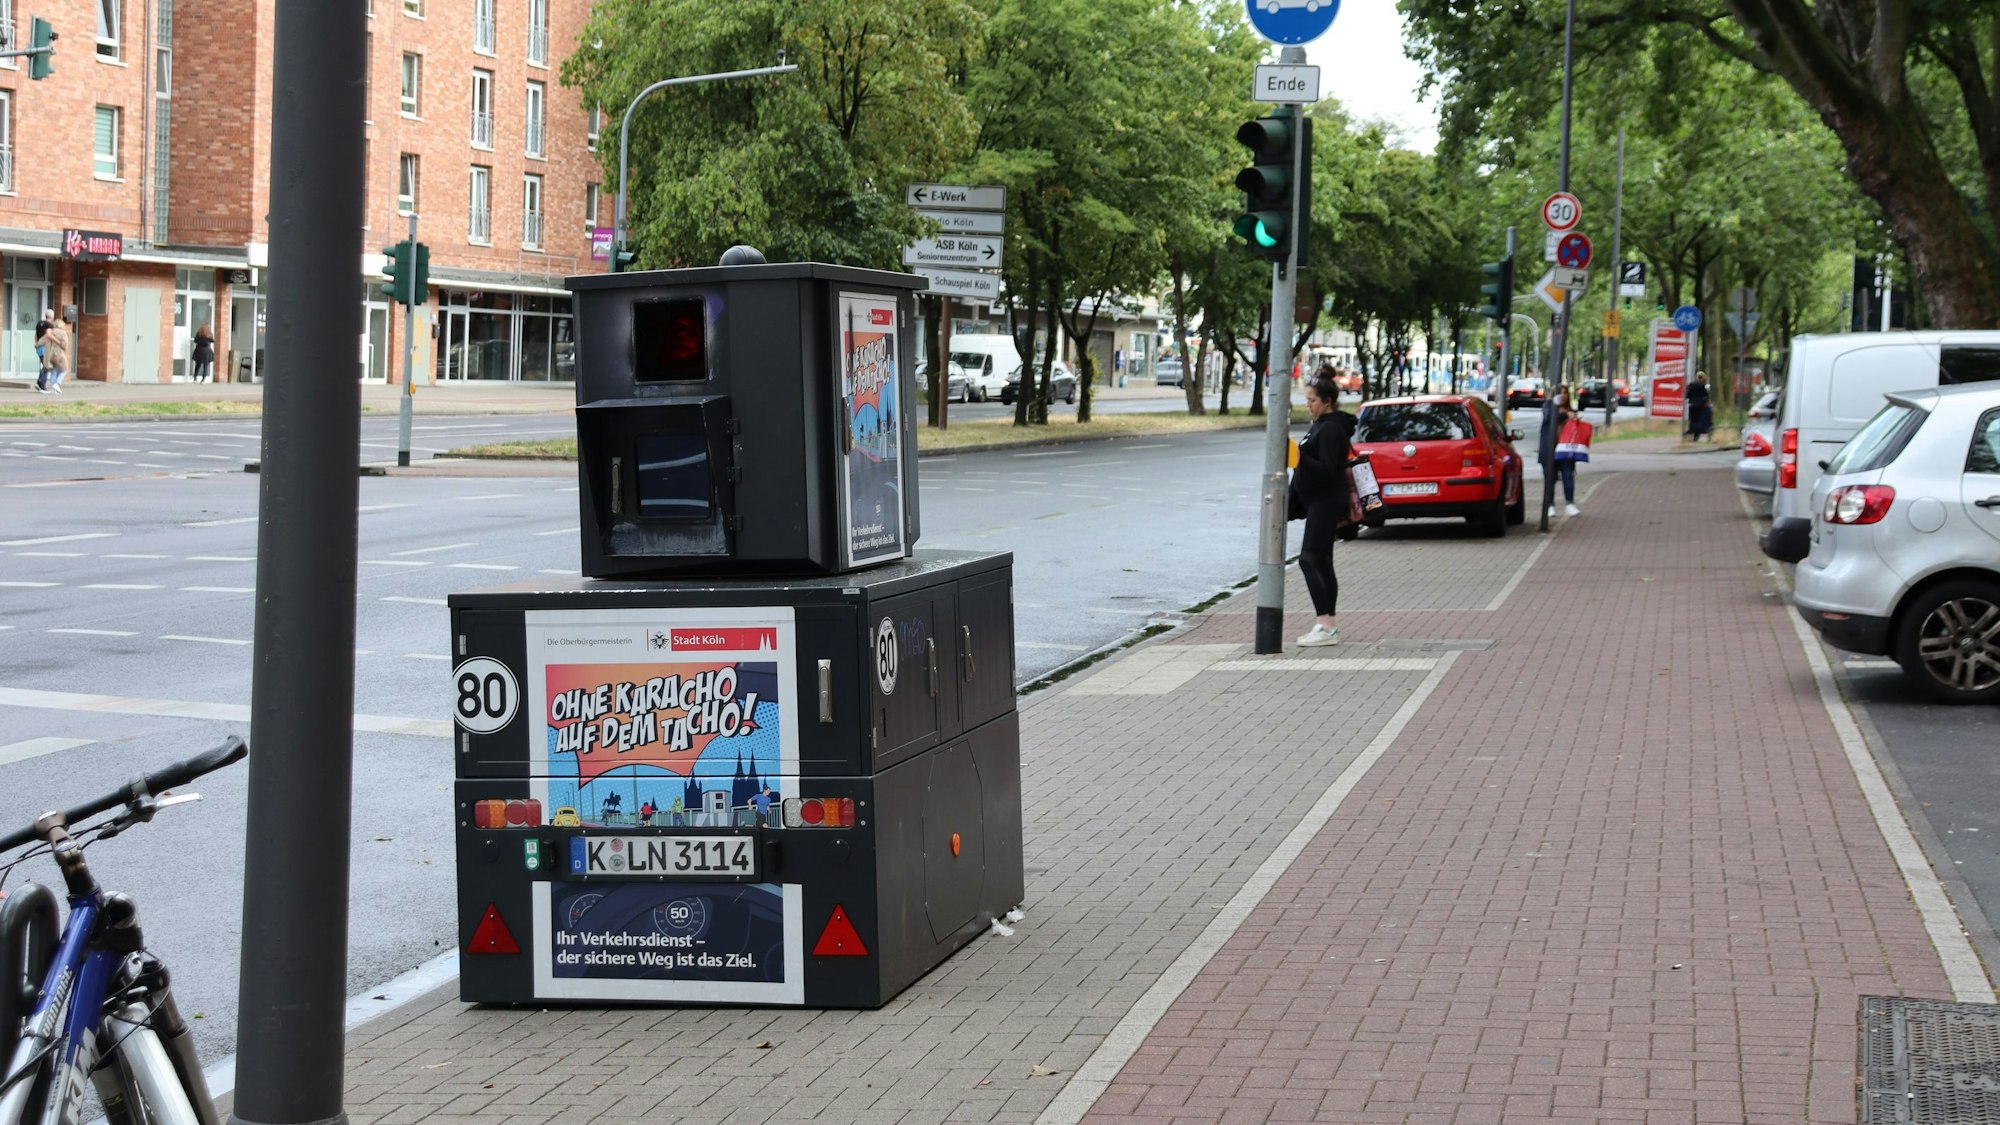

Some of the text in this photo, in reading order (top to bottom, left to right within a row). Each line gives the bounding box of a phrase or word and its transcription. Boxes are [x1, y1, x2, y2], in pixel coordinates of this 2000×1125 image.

[1268, 76, 1306, 91] Ende
[931, 190, 967, 202] E-Werk
[1550, 203, 1572, 221] 30
[953, 217, 974, 227] Köln
[935, 239, 978, 251] ASB Köln
[917, 251, 977, 262] Seniorenzentrum
[934, 275, 991, 290] Schauspiel Köln
[547, 637, 633, 647] Die Oberbürgermeisterin
[673, 635, 726, 645] Stadt Köln
[880, 631, 895, 681] 80
[457, 672, 507, 719] 80
[552, 666, 738, 722] OHNE KARACHO
[555, 692, 758, 754] AUF DEM TACHO!
[588, 841, 749, 871] K LN 3114
[574, 859, 582, 869] D
[670, 906, 689, 919] 50
[556, 931, 577, 946] Ihr
[580, 931, 693, 947] Verkehrsdienst
[557, 950, 757, 969] der sichere Weg ist das Ziel.
[65, 1026, 101, 1125] KTM
